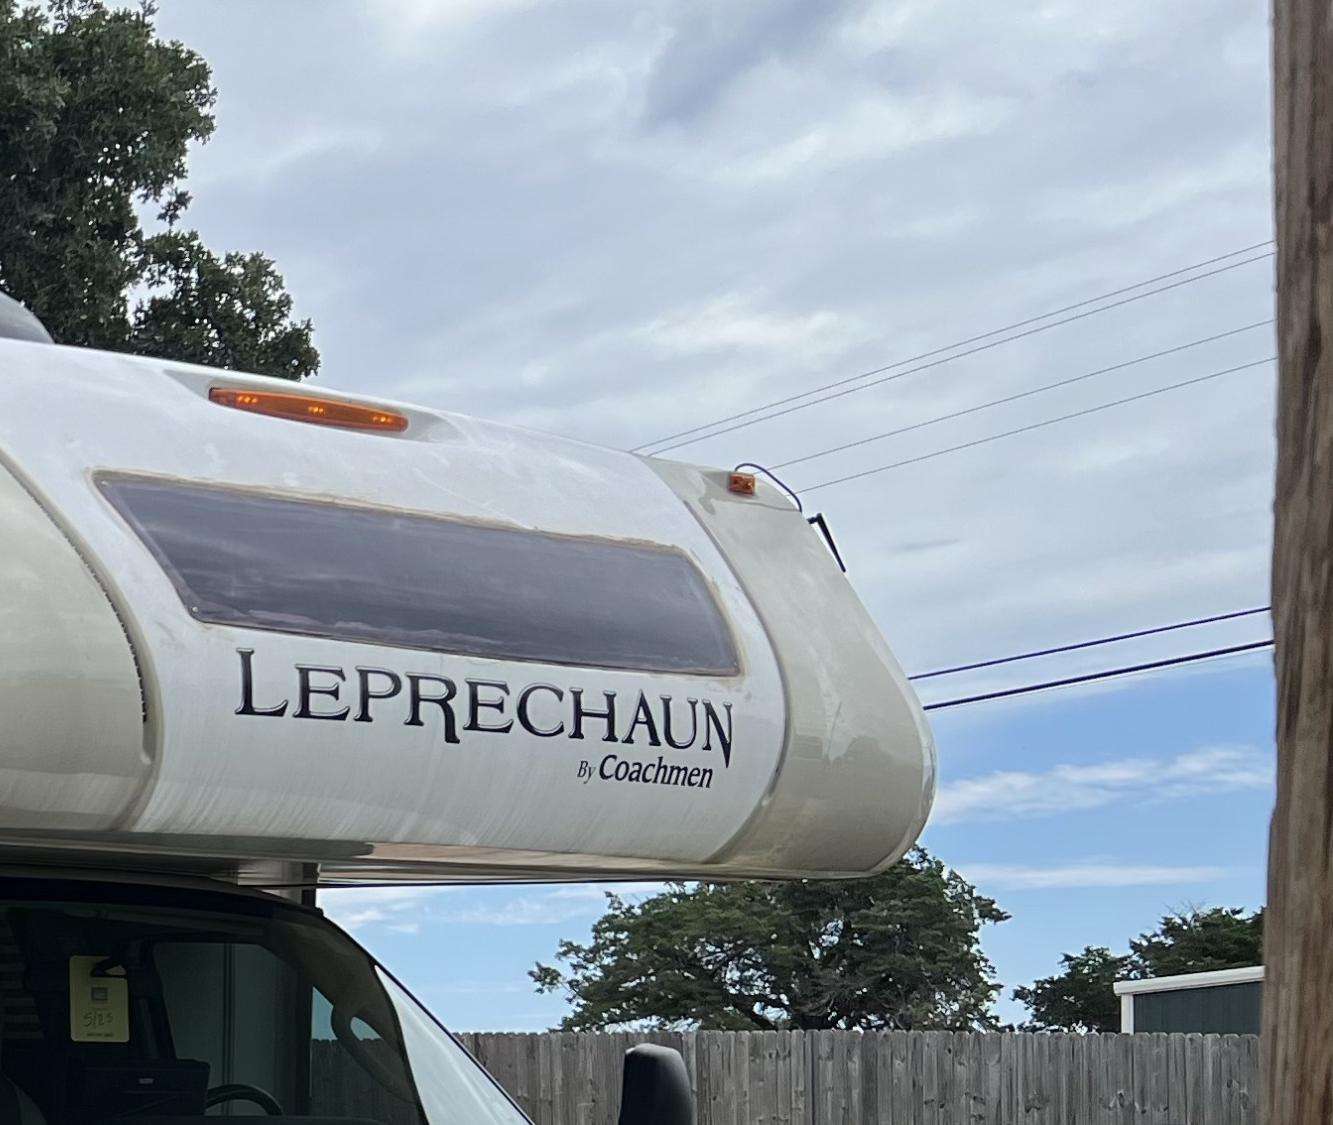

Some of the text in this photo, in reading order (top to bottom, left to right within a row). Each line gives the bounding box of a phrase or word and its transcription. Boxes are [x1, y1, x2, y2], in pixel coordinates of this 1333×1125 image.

[234, 647, 733, 768] LEPRECHAUN
[577, 754, 714, 789] By Coachmen
